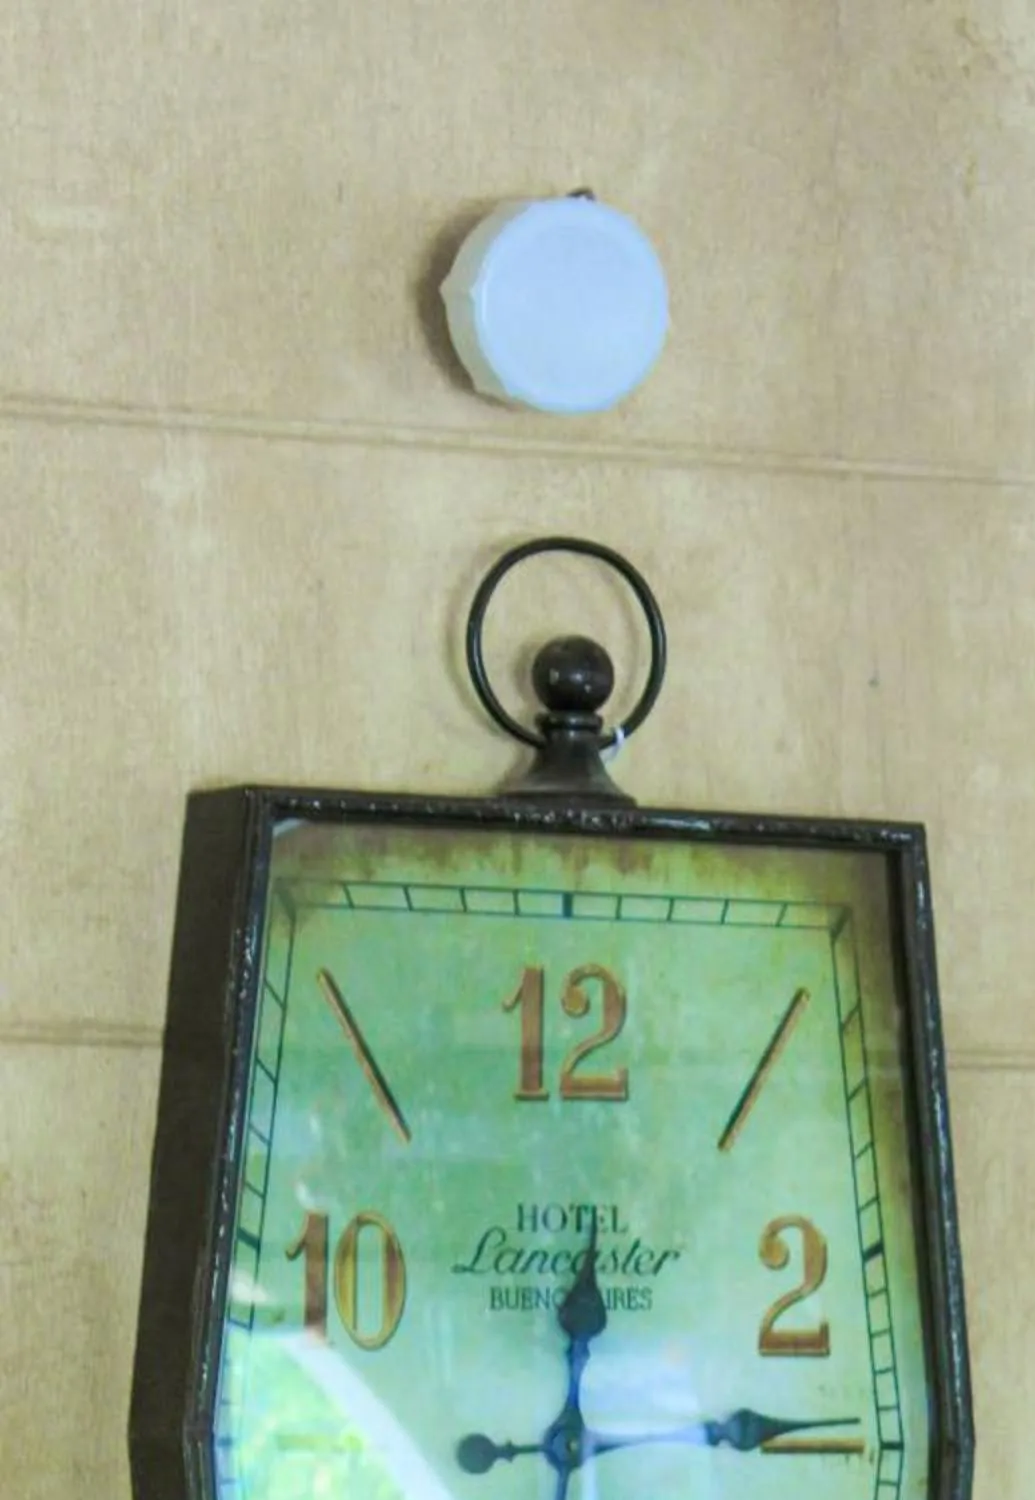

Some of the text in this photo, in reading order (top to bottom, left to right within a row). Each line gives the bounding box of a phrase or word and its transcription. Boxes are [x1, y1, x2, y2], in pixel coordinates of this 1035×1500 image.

[502, 963, 629, 1101] 12
[285, 1211, 407, 1350] 10
[517, 1203, 628, 1233] HOTEL
[758, 1215, 830, 1357] 2
[603, 1286, 652, 1312] IRES
